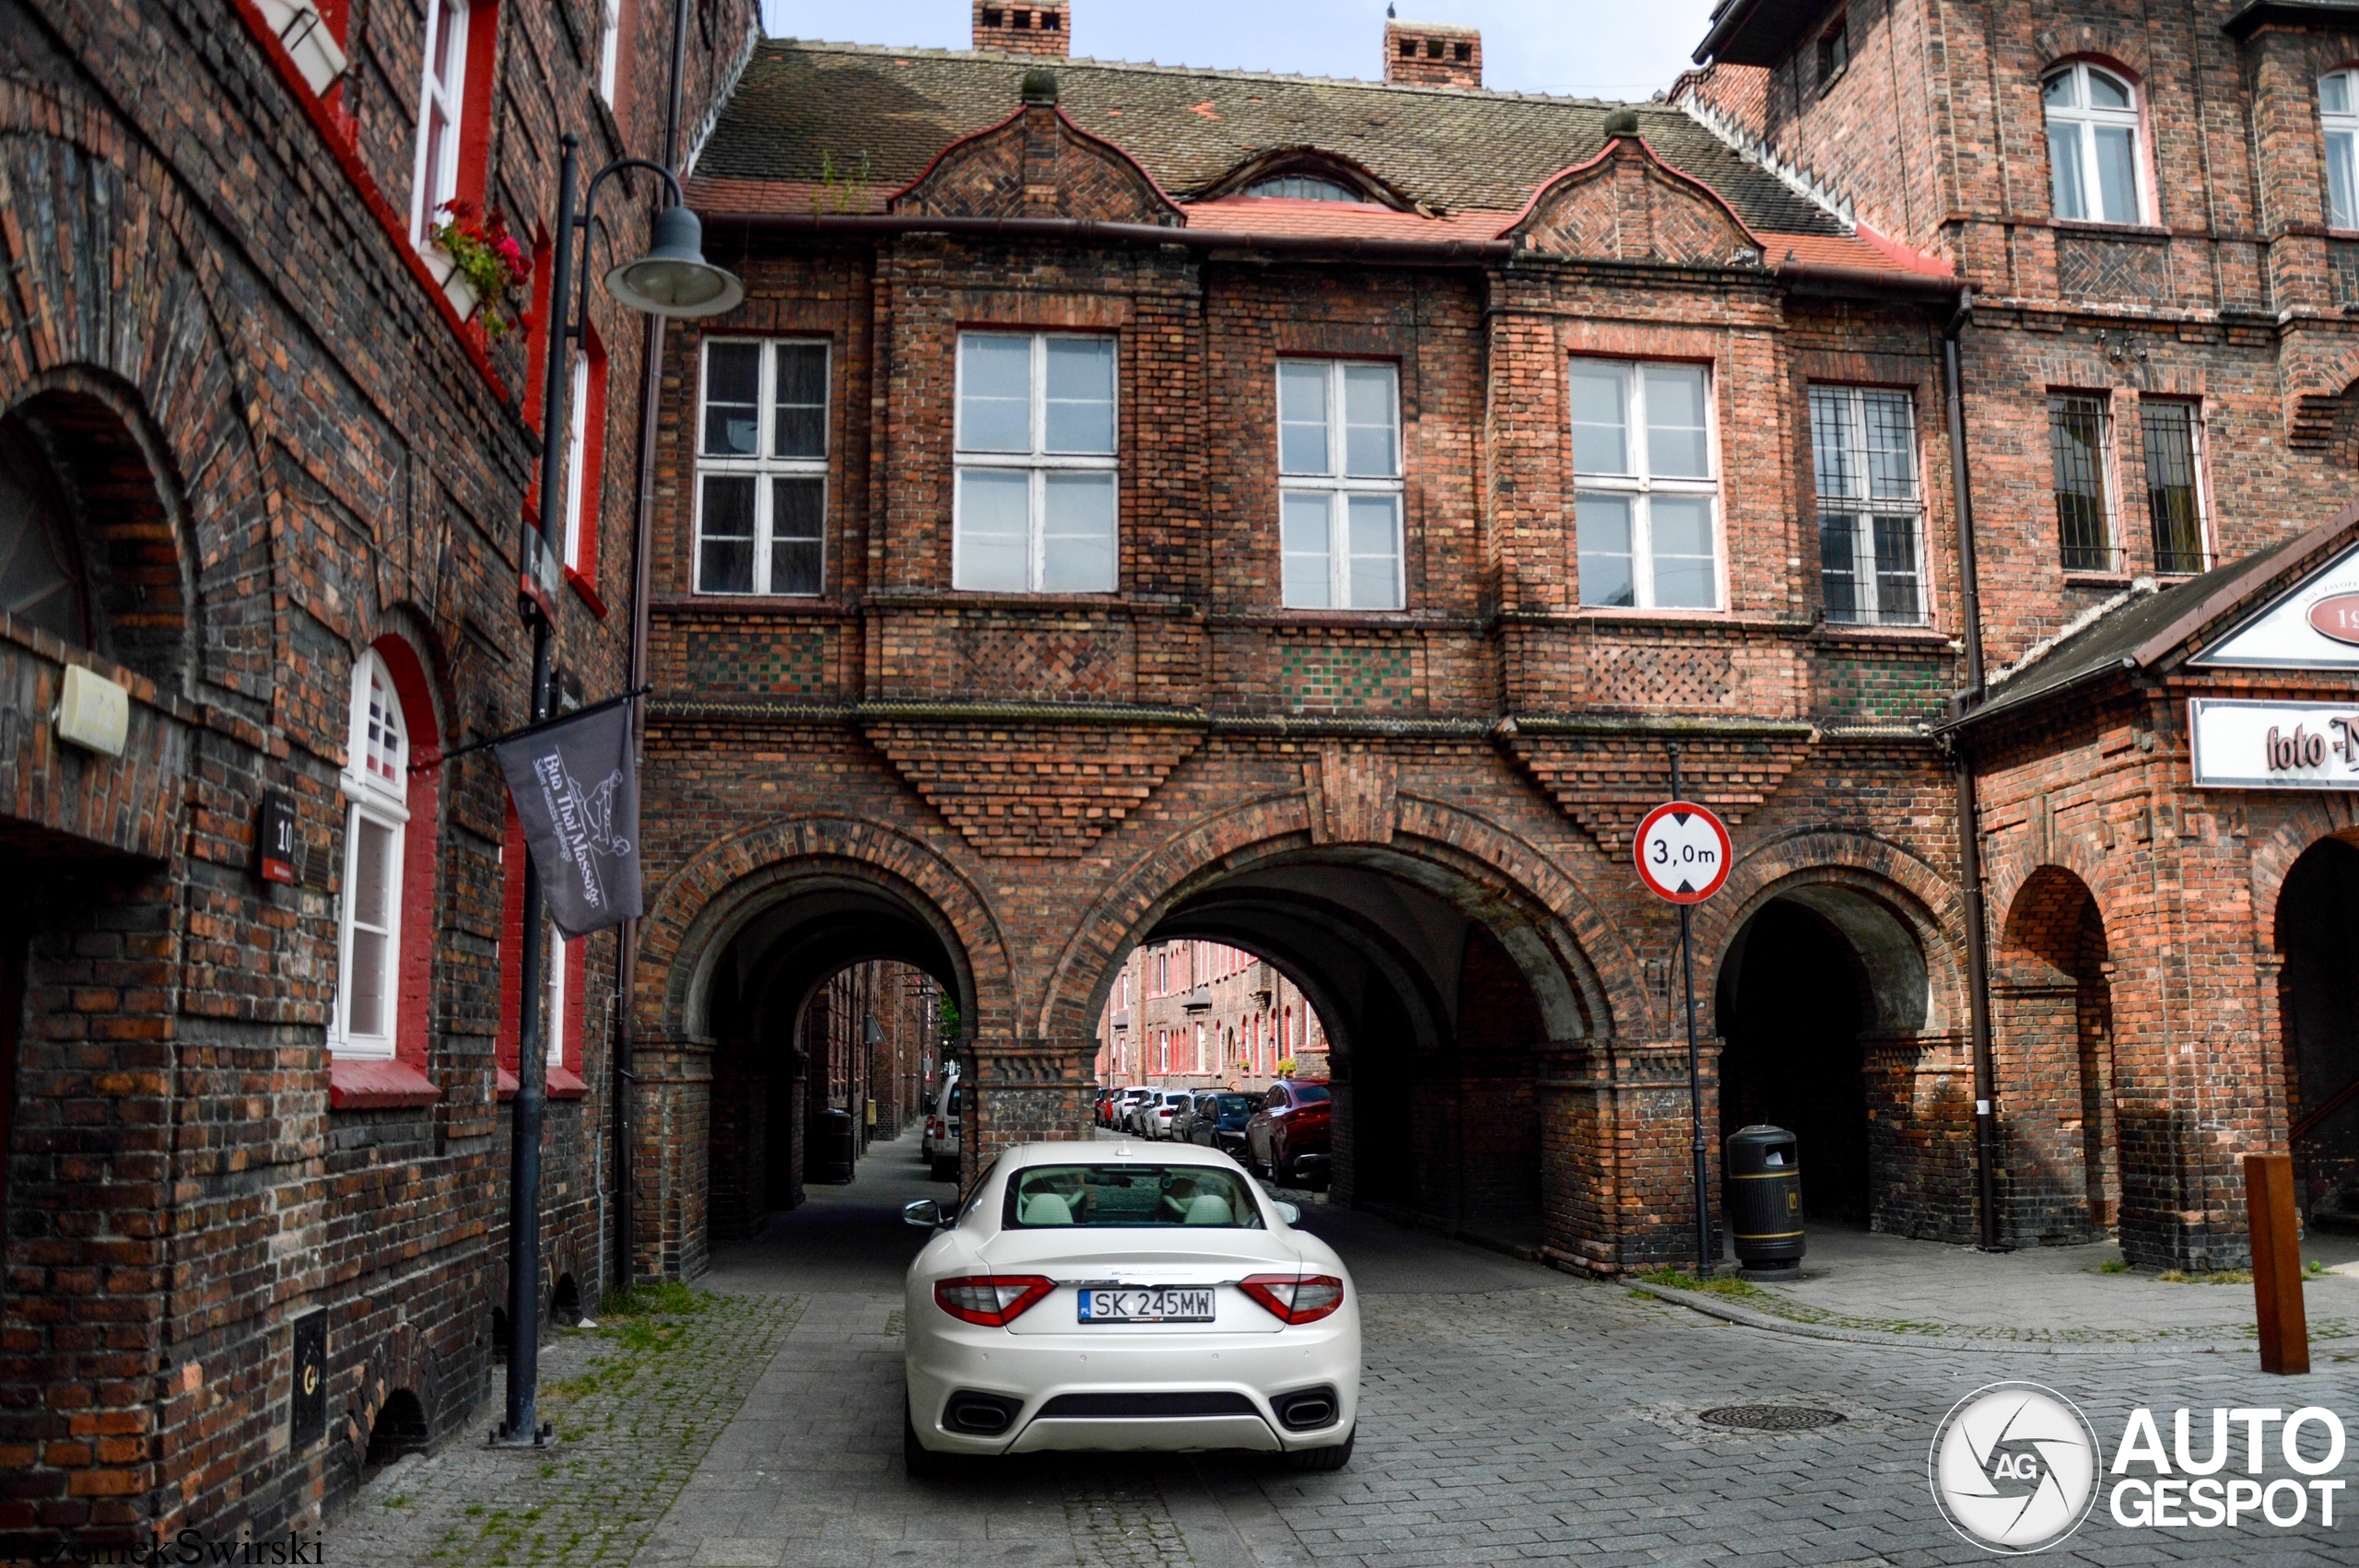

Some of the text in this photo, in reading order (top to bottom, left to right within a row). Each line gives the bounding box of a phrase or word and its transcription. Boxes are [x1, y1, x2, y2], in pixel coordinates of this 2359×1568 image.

[2267, 722, 2326, 771] foto
[533, 758, 546, 786] Salon
[278, 820, 292, 853] 10
[543, 754, 599, 908] Bua Thai Massage
[1096, 1293, 1209, 1316] SK 245MW
